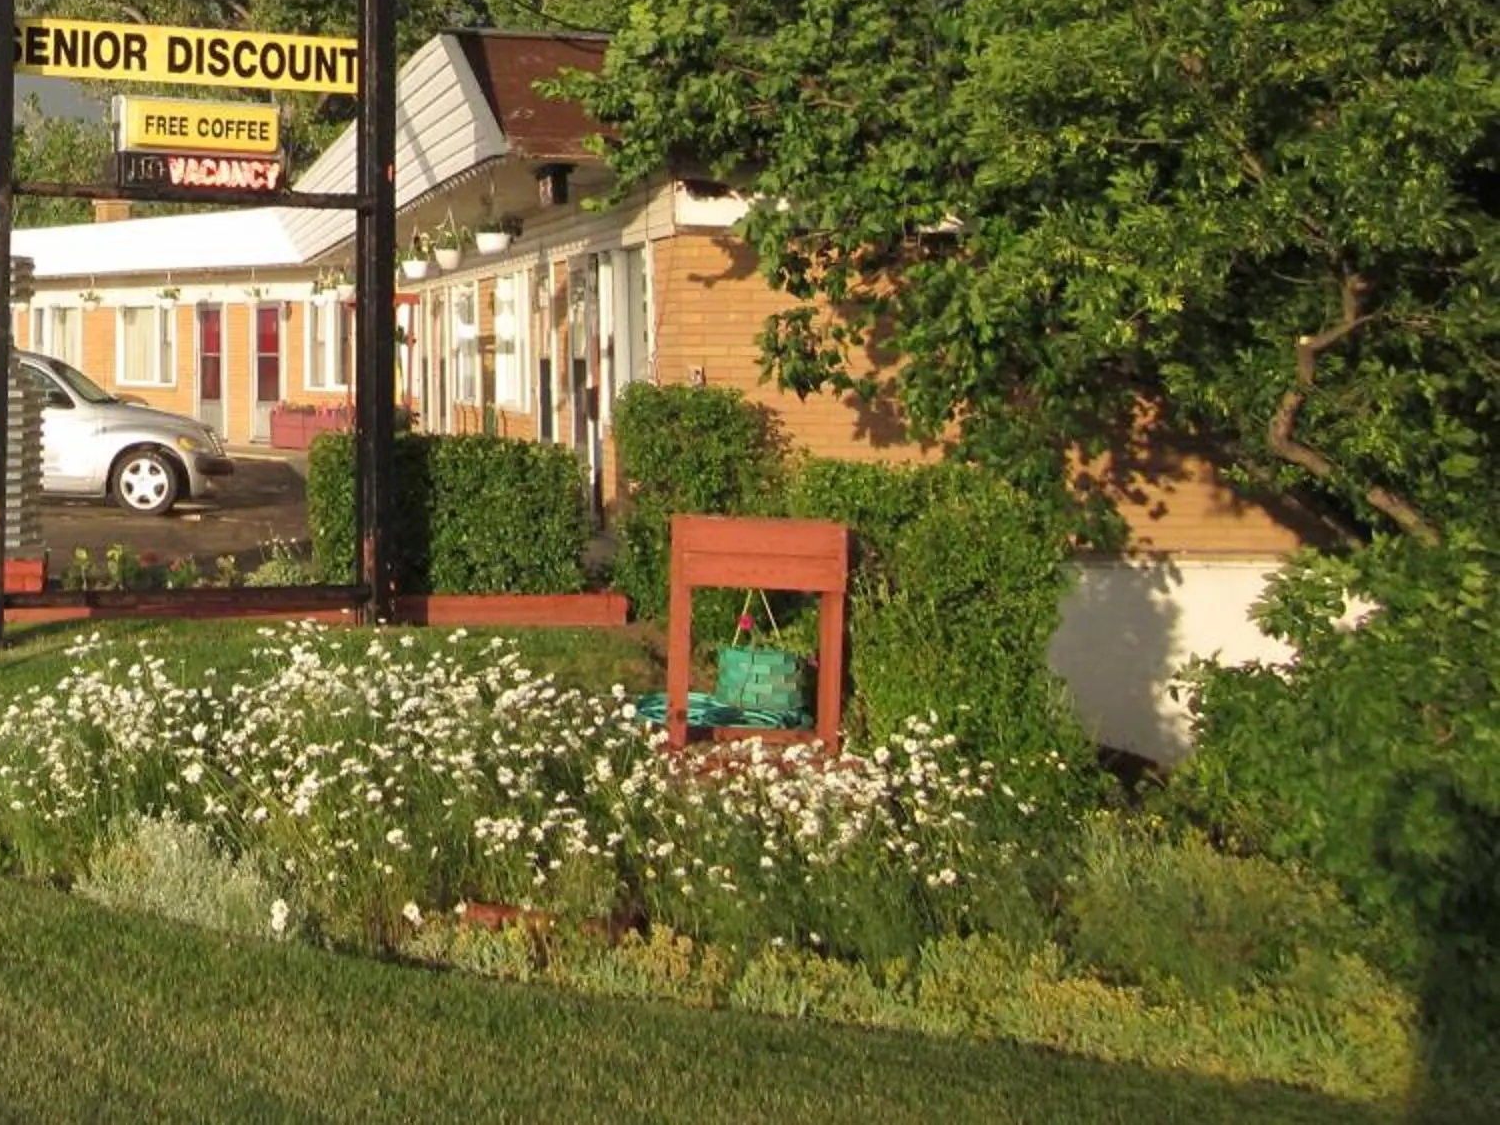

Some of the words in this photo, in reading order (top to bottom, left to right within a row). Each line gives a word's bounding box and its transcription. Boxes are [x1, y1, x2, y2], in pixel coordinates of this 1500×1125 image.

[167, 36, 358, 84] DISCOUNT
[145, 114, 189, 136] FREE
[197, 117, 270, 141] COFFEE
[168, 155, 280, 190] VACANCY
